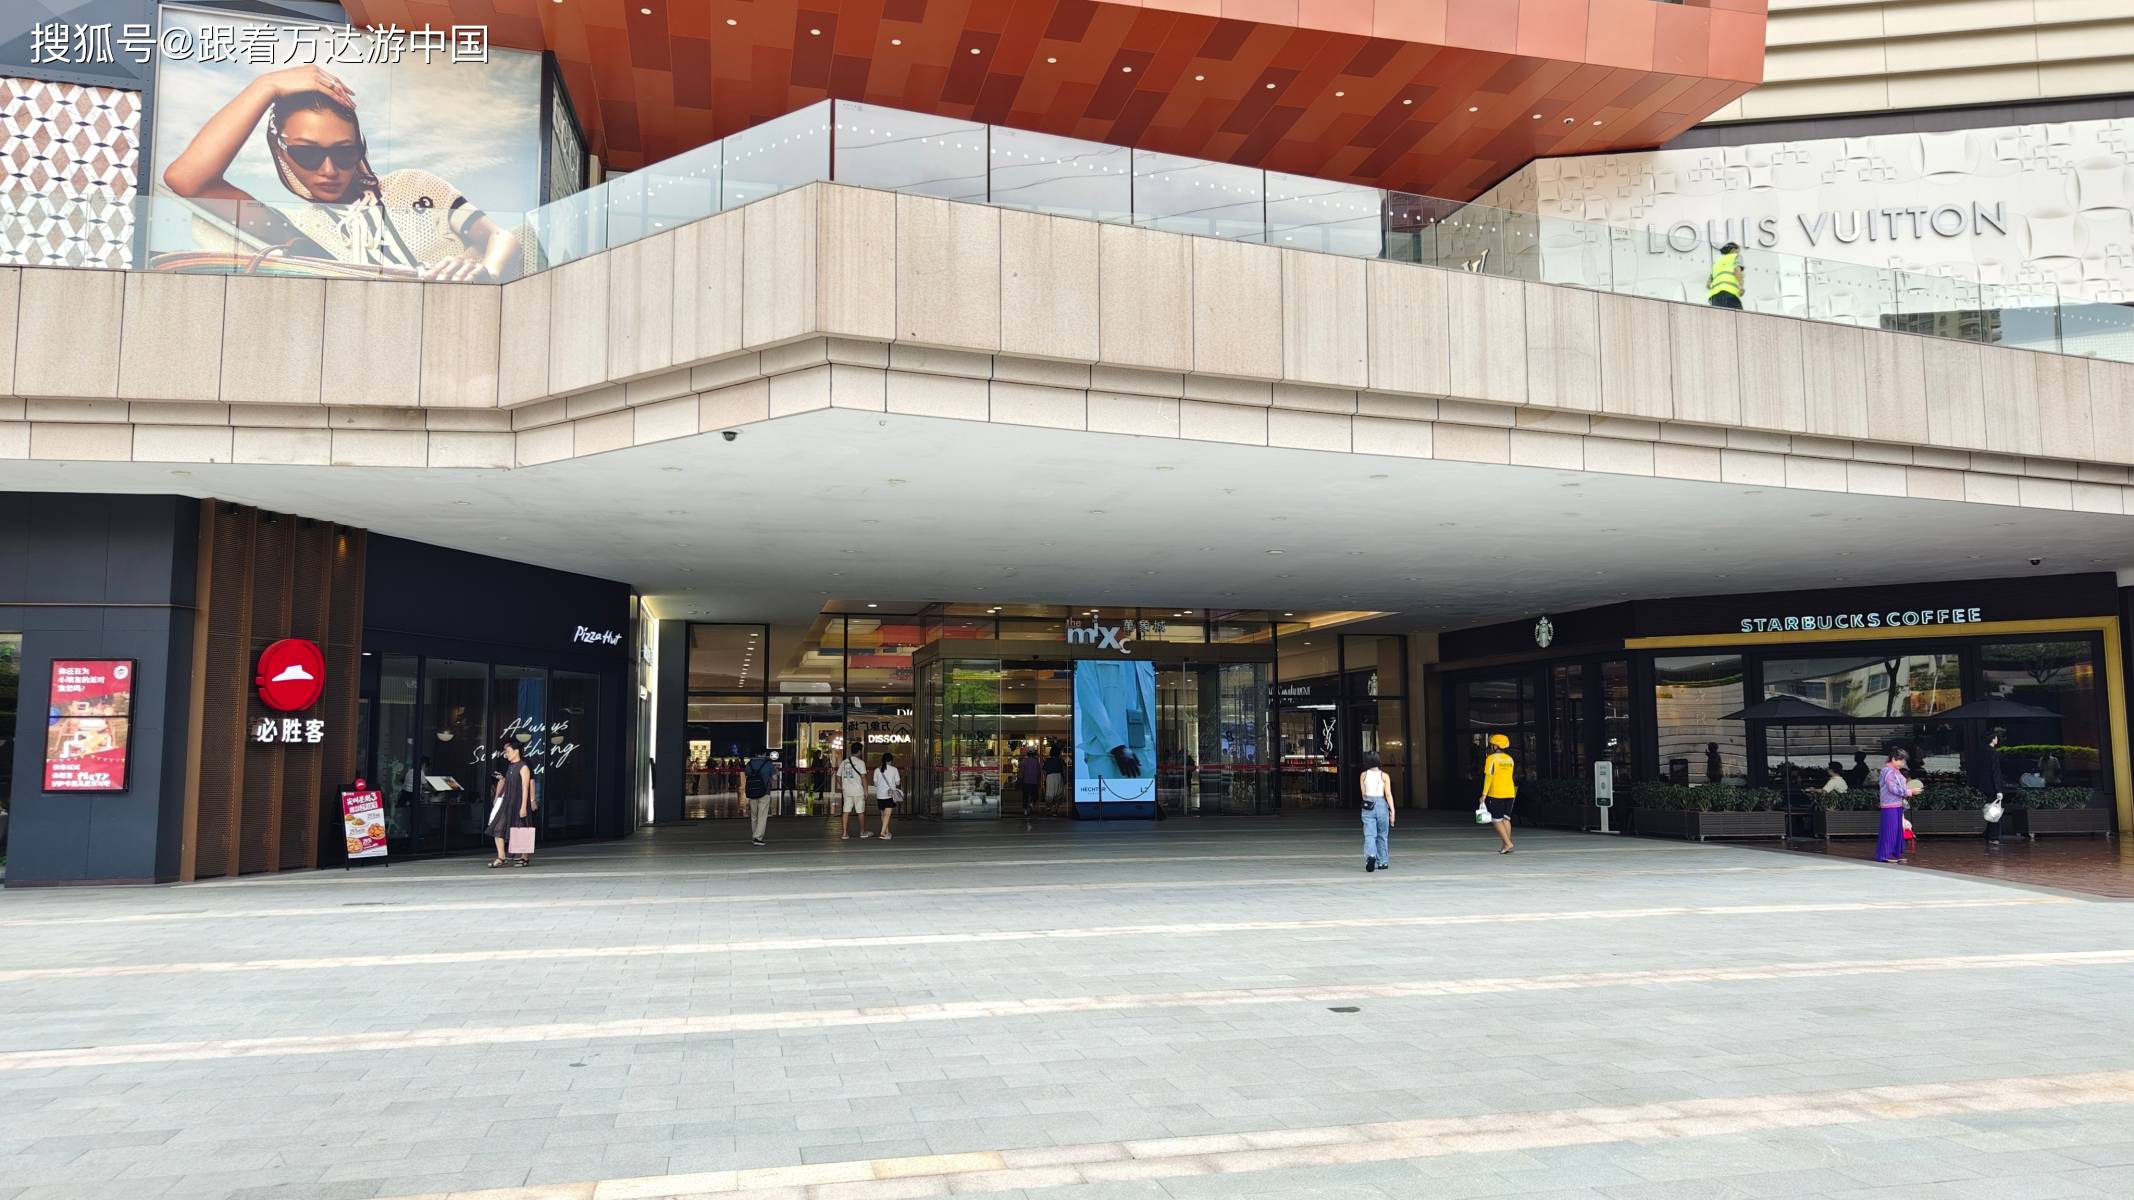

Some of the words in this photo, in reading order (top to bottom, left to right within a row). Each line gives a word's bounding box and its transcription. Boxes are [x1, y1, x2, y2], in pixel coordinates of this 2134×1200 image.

[1647, 214, 1779, 254] LOUIS
[1797, 201, 2007, 246] VUITTON
[1740, 612, 1881, 633] STARBUCKS
[1885, 607, 1983, 627] COFFEE
[573, 625, 602, 644] Pizza
[602, 629, 623, 645] Hut
[256, 717, 325, 743] 必胜客
[868, 734, 912, 744] DISSONA
